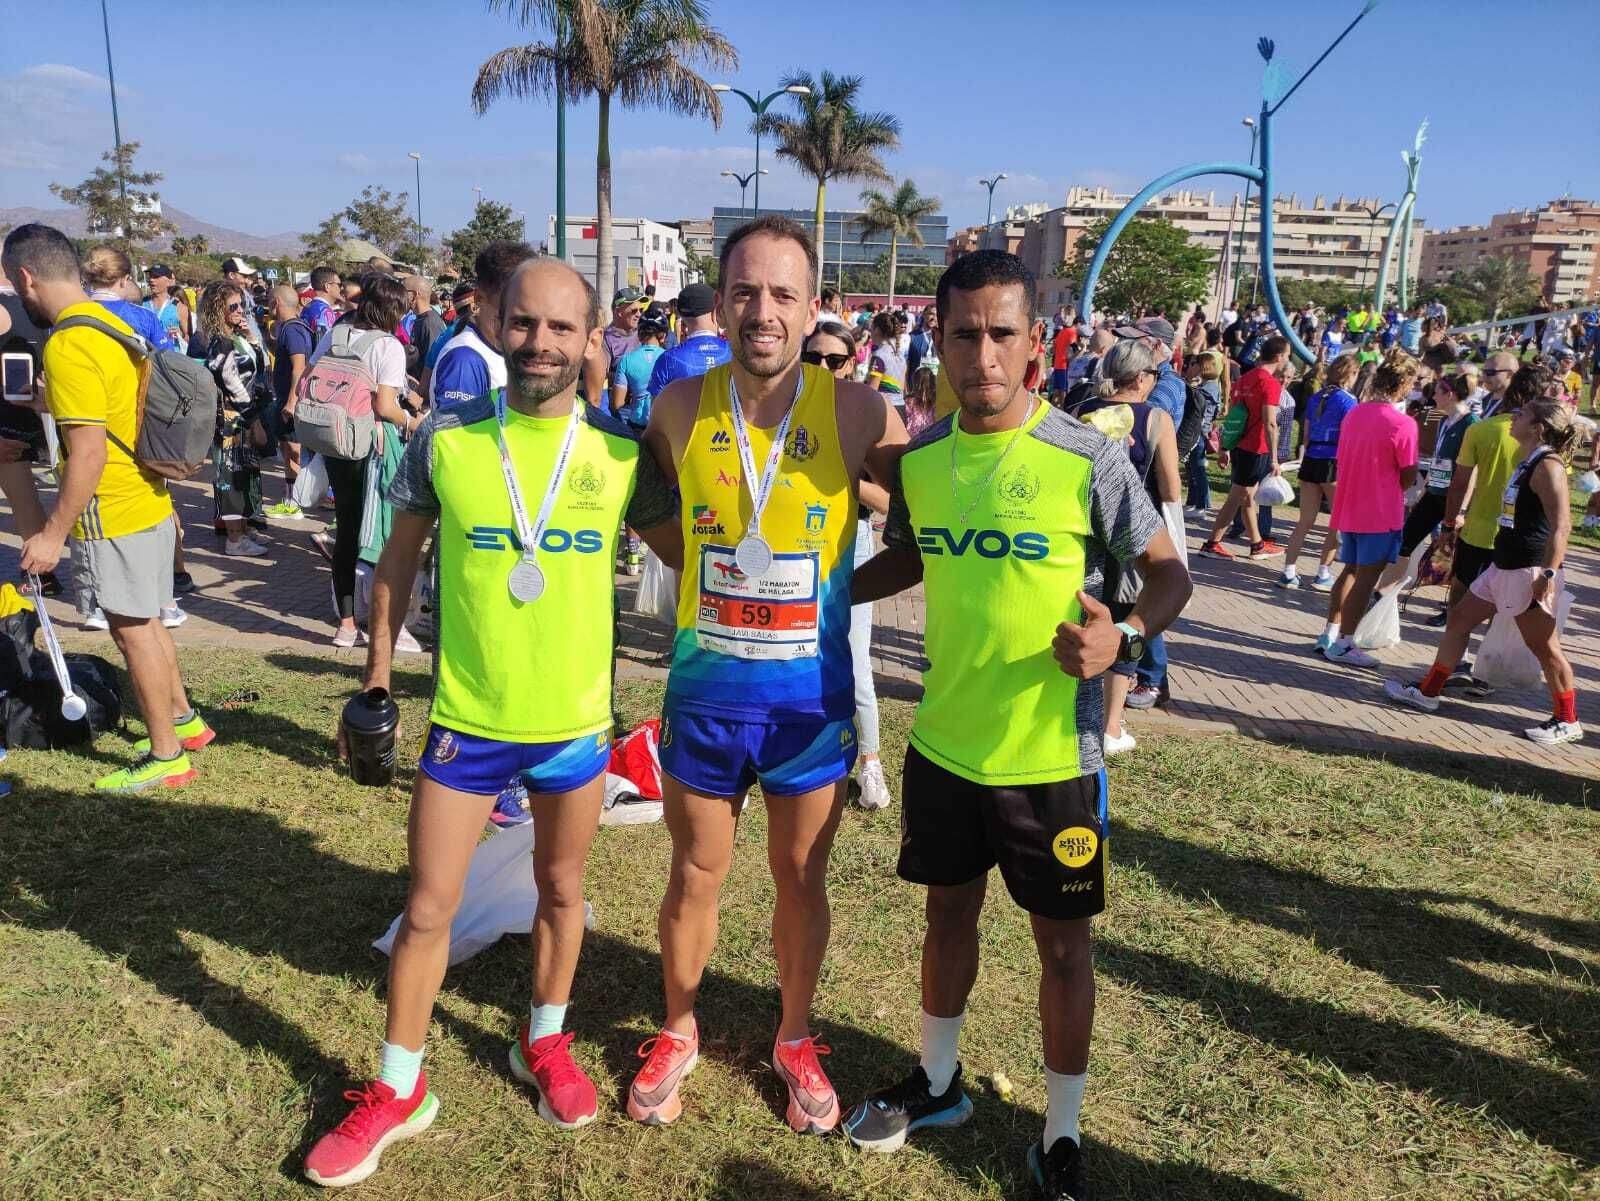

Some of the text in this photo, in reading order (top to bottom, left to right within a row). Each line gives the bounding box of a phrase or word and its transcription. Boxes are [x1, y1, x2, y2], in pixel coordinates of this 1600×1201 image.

[917, 527, 1050, 561] EVOS
[741, 604, 772, 626] 59
[731, 629, 778, 640] JAVI SALAS
